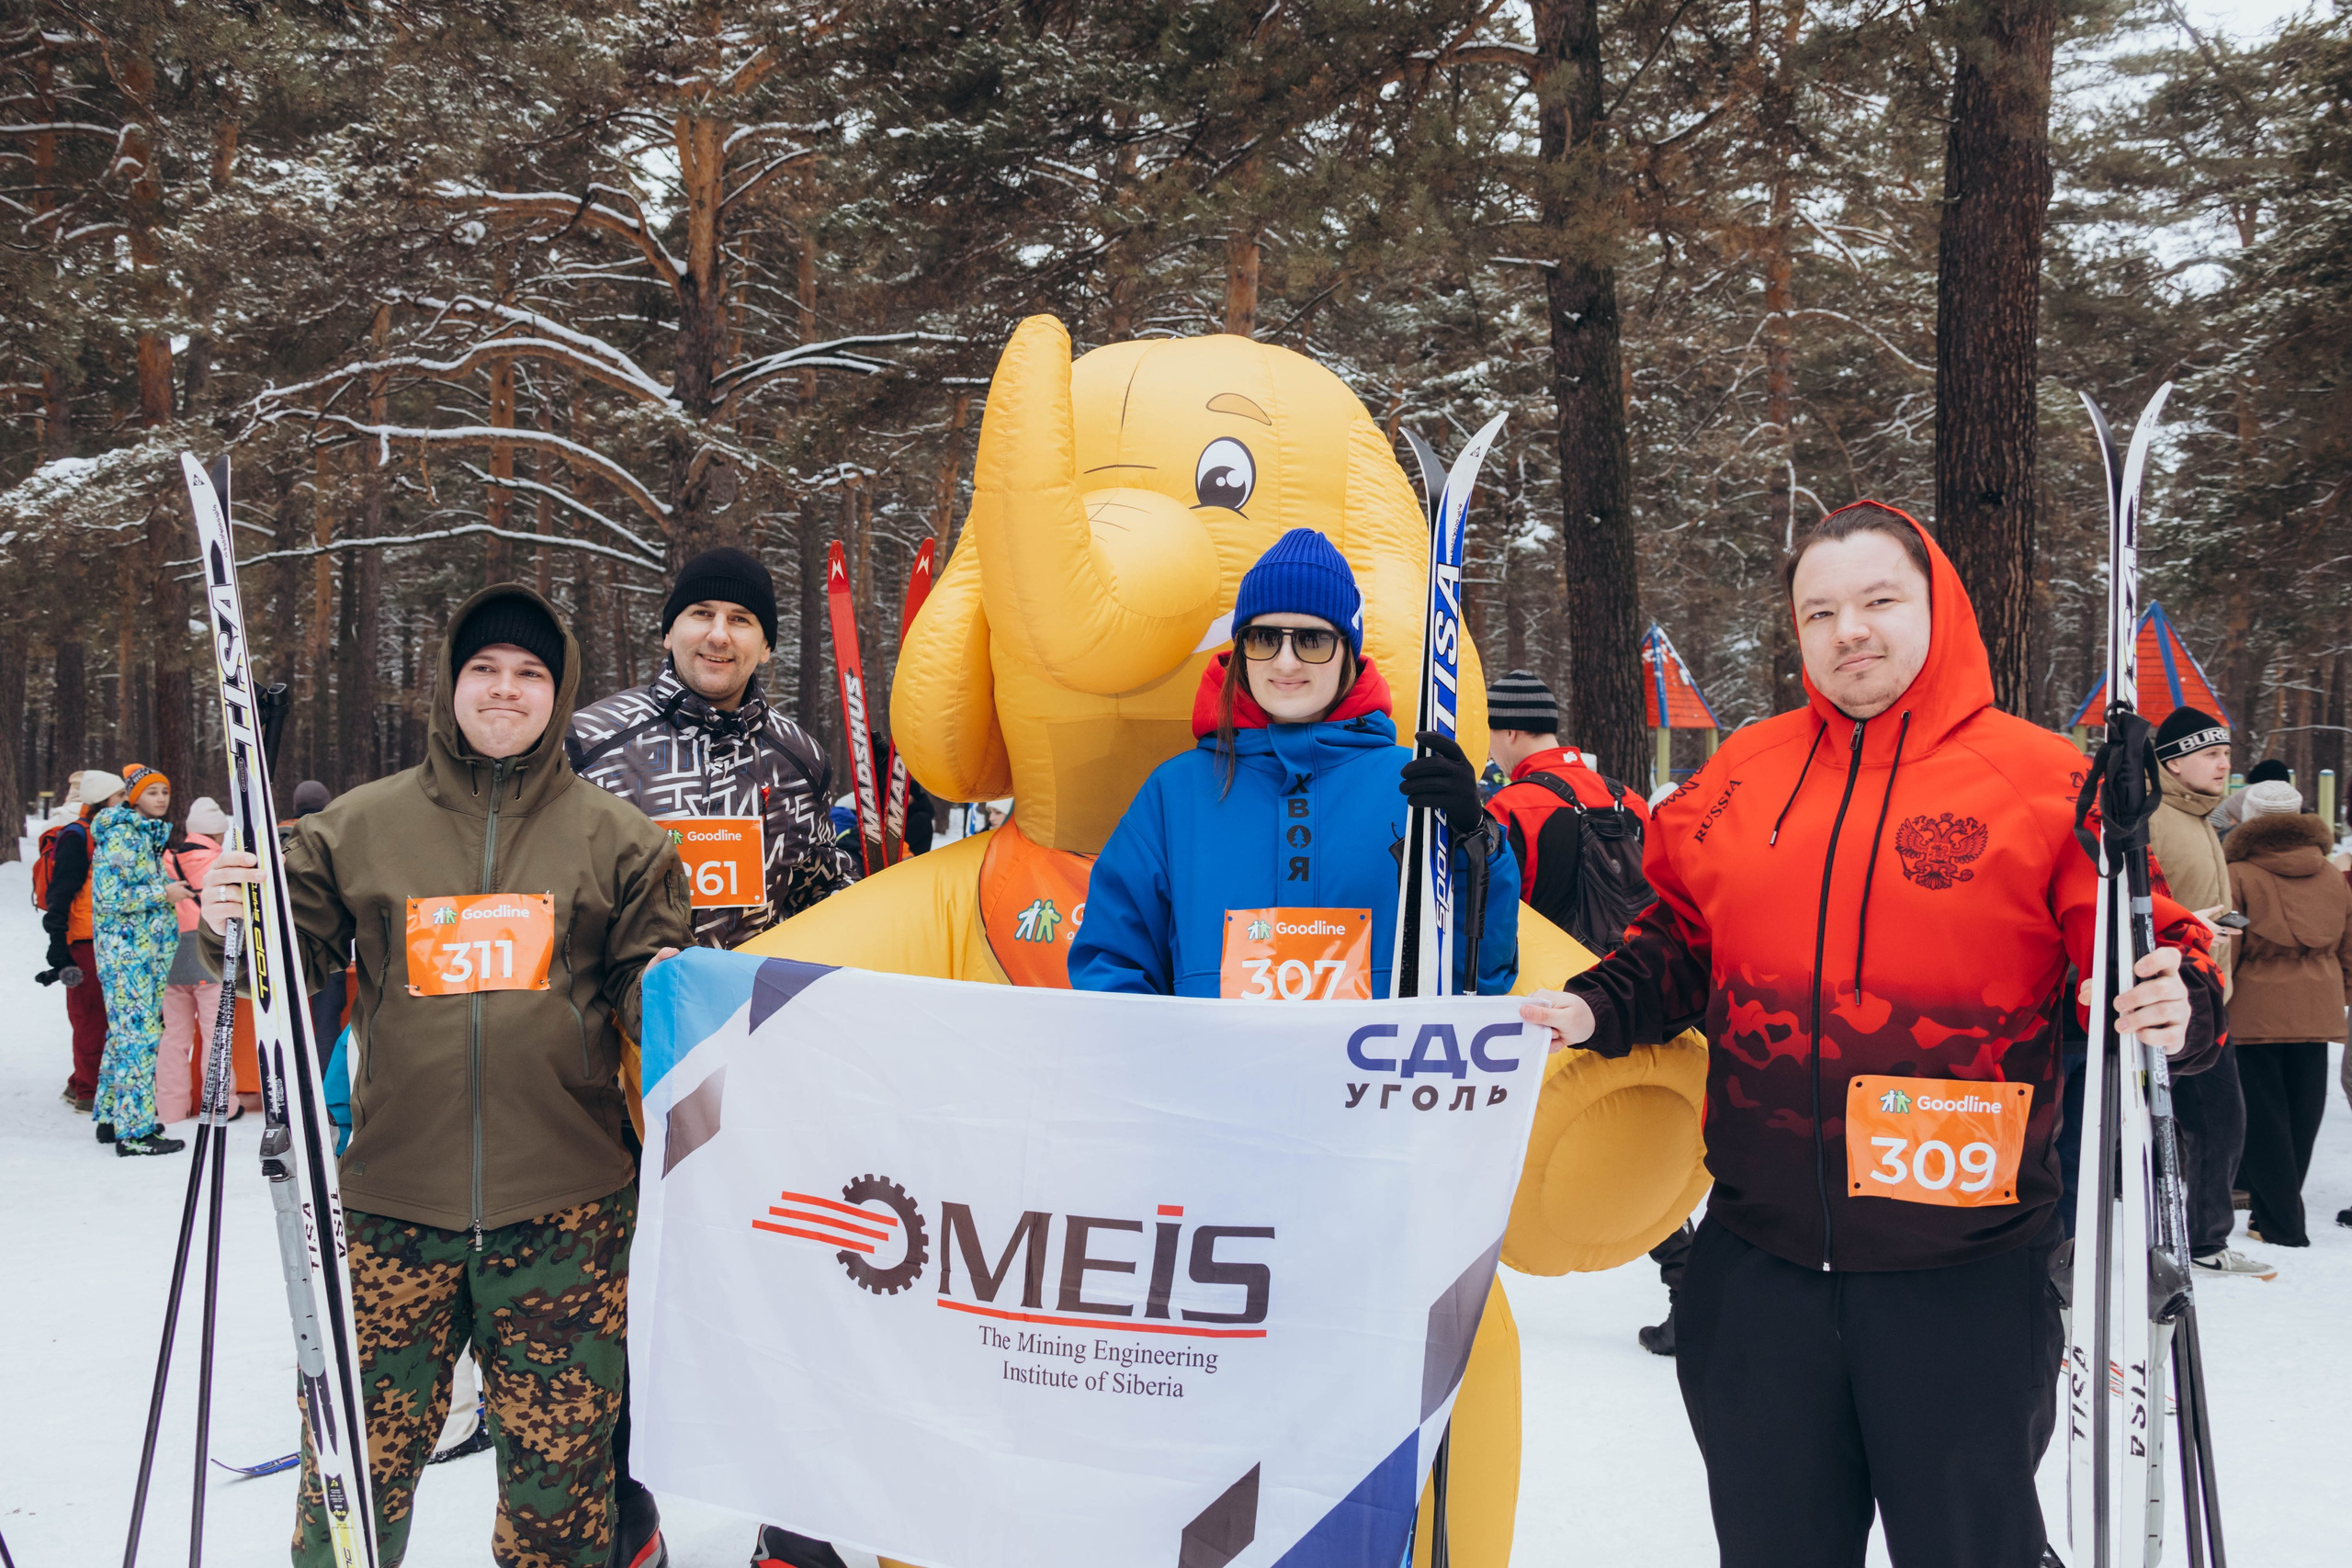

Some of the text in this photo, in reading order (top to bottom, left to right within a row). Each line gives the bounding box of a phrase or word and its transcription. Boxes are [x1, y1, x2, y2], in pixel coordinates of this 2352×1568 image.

[210, 582, 253, 757] TISA
[1431, 562, 1460, 733] TISA
[844, 672, 883, 844] MADSHUS
[687, 829, 742, 841] Goodline
[1693, 779, 1743, 844] RUSSIA
[461, 905, 530, 920] Goodline
[1275, 919, 1346, 936] Goodline
[254, 926, 269, 998] TOP
[441, 940, 513, 983] 311
[1240, 959, 1347, 1000] 307
[1346, 1021, 1523, 1079] СДС
[1344, 1082, 1508, 1111] УГОЛЬ
[1917, 1095, 2003, 1114] Goodline
[1870, 1136, 1997, 1192] 309
[302, 1202, 320, 1274] TISA
[331, 1188, 347, 1258] TISA
[978, 1325, 1219, 1374] The Mining Engineering
[1002, 1359, 1185, 1398] Institute of Siberia
[2071, 1345, 2089, 1442] TISA
[2130, 1359, 2146, 1458] TISA
